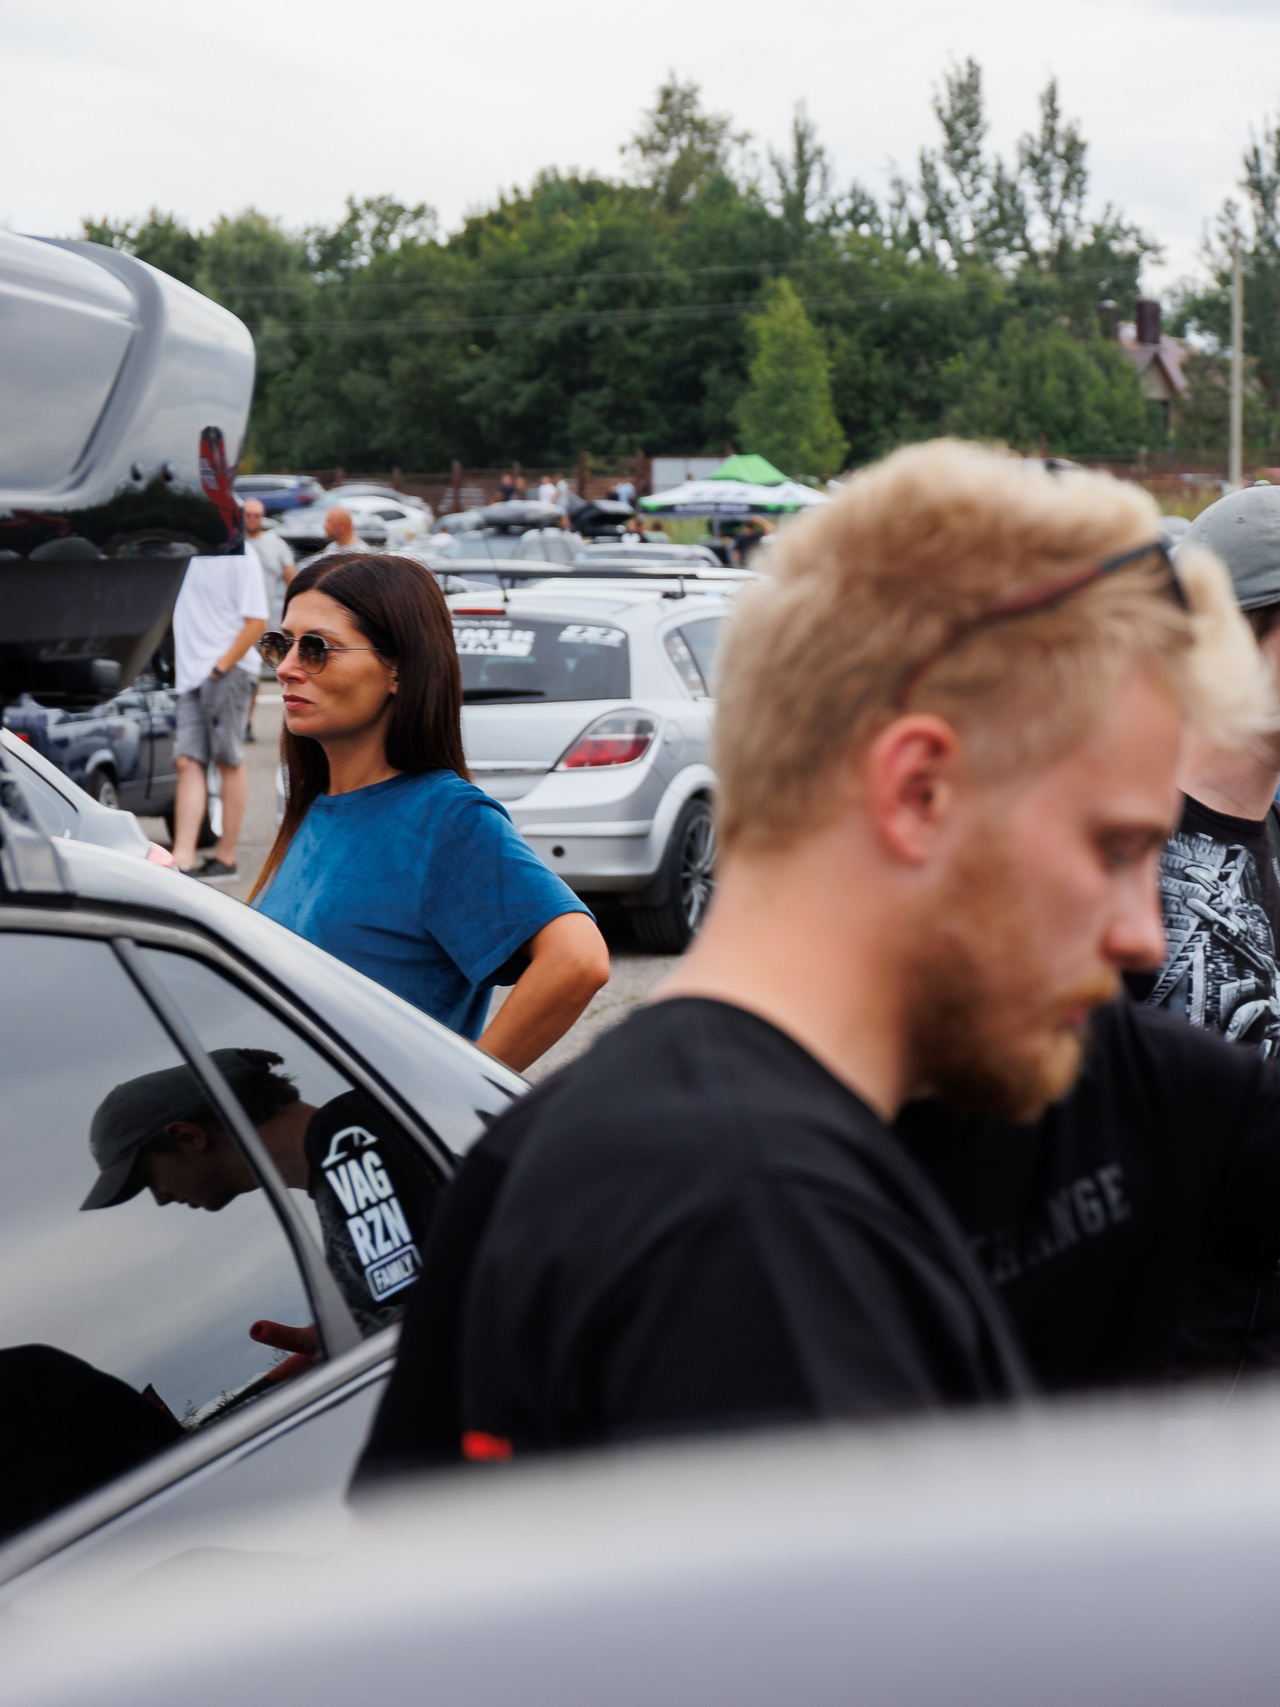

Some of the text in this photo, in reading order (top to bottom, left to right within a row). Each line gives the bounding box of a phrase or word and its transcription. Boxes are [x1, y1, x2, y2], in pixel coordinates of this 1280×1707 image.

[325, 1150, 394, 1216] VAG
[346, 1196, 413, 1266] RZN
[371, 1251, 416, 1293] FAMILY
